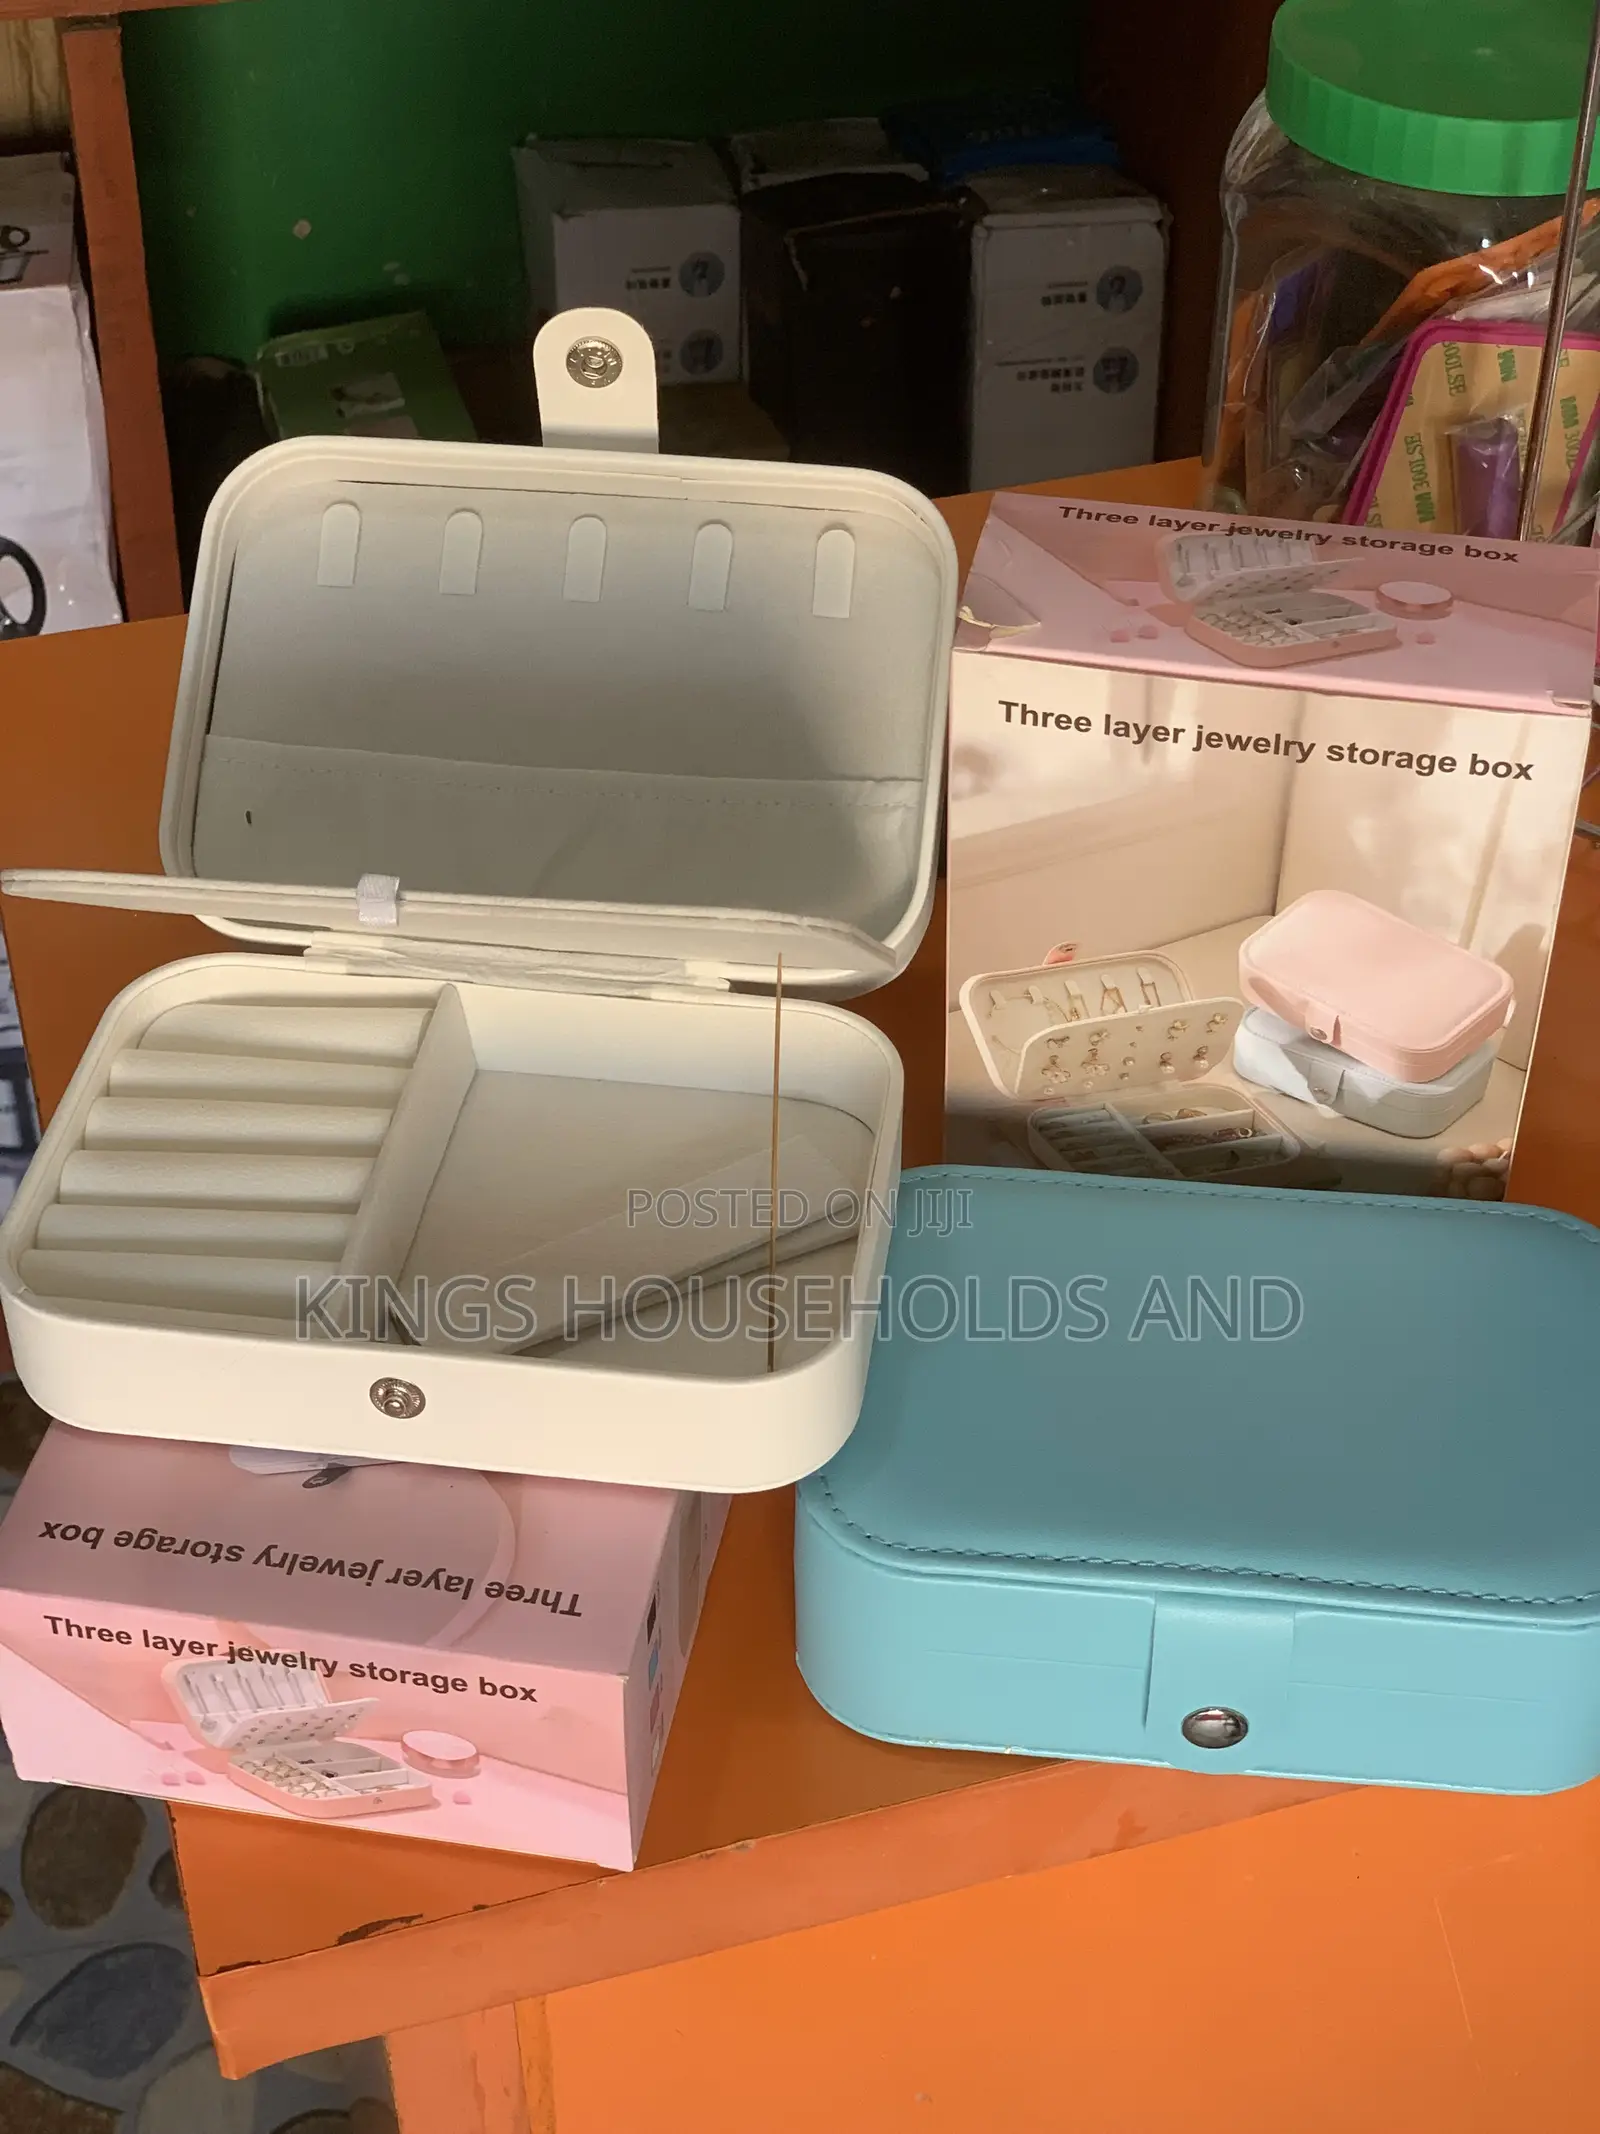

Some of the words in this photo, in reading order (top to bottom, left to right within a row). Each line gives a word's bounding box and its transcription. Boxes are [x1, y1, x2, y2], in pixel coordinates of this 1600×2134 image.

[1058, 506, 1139, 525] Three
[1148, 514, 1221, 532] layer
[1225, 521, 1333, 546] jewelry
[1341, 534, 1454, 556] storage
[1464, 545, 1519, 563] box
[998, 700, 1092, 733] Three
[1104, 714, 1186, 745] layer
[1192, 724, 1316, 763] jewelry
[1326, 742, 1457, 777] storage
[1469, 754, 1534, 780] box
[38, 1521, 105, 1550] box
[113, 1528, 246, 1564] storage
[252, 1544, 384, 1587] jewelry
[385, 1567, 474, 1600] layer
[484, 1581, 582, 1617] Three
[43, 1615, 132, 1645] Three
[142, 1629, 218, 1657] layer
[226, 1641, 338, 1678] jewelry
[349, 1661, 468, 1694] storage
[479, 1677, 538, 1703] box
